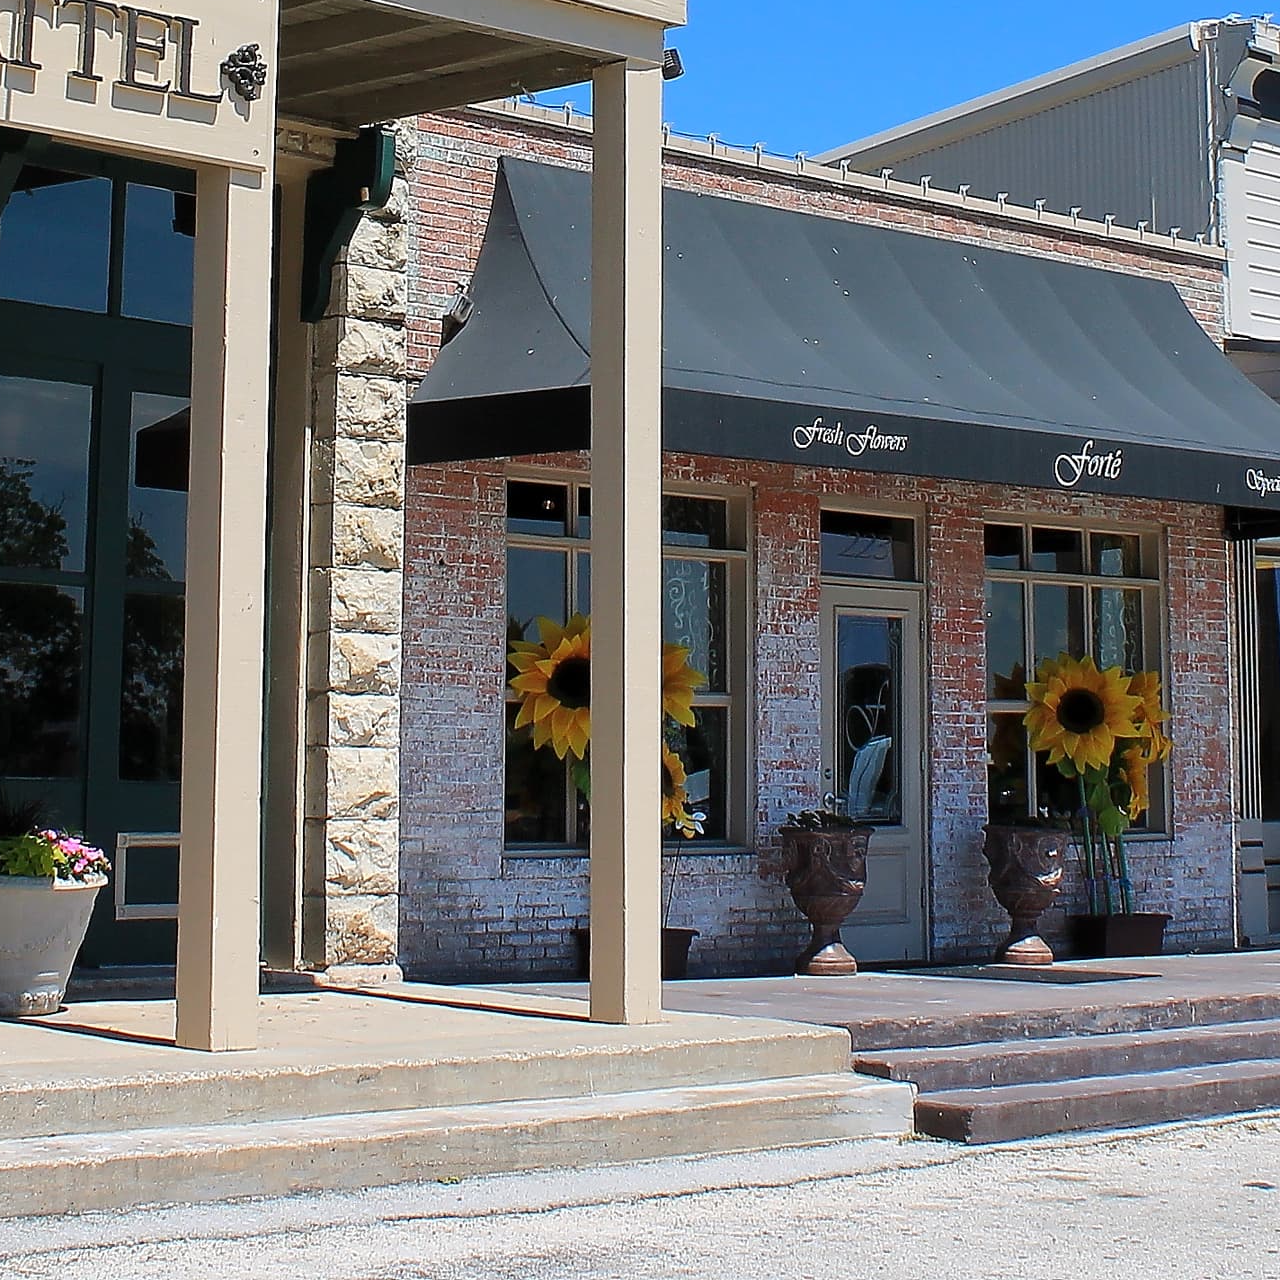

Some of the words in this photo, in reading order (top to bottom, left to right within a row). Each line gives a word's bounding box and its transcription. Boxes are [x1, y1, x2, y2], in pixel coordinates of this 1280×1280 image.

[793, 417, 845, 449] Fresh
[846, 424, 909, 456] Flowers
[1054, 440, 1123, 488] Forté
